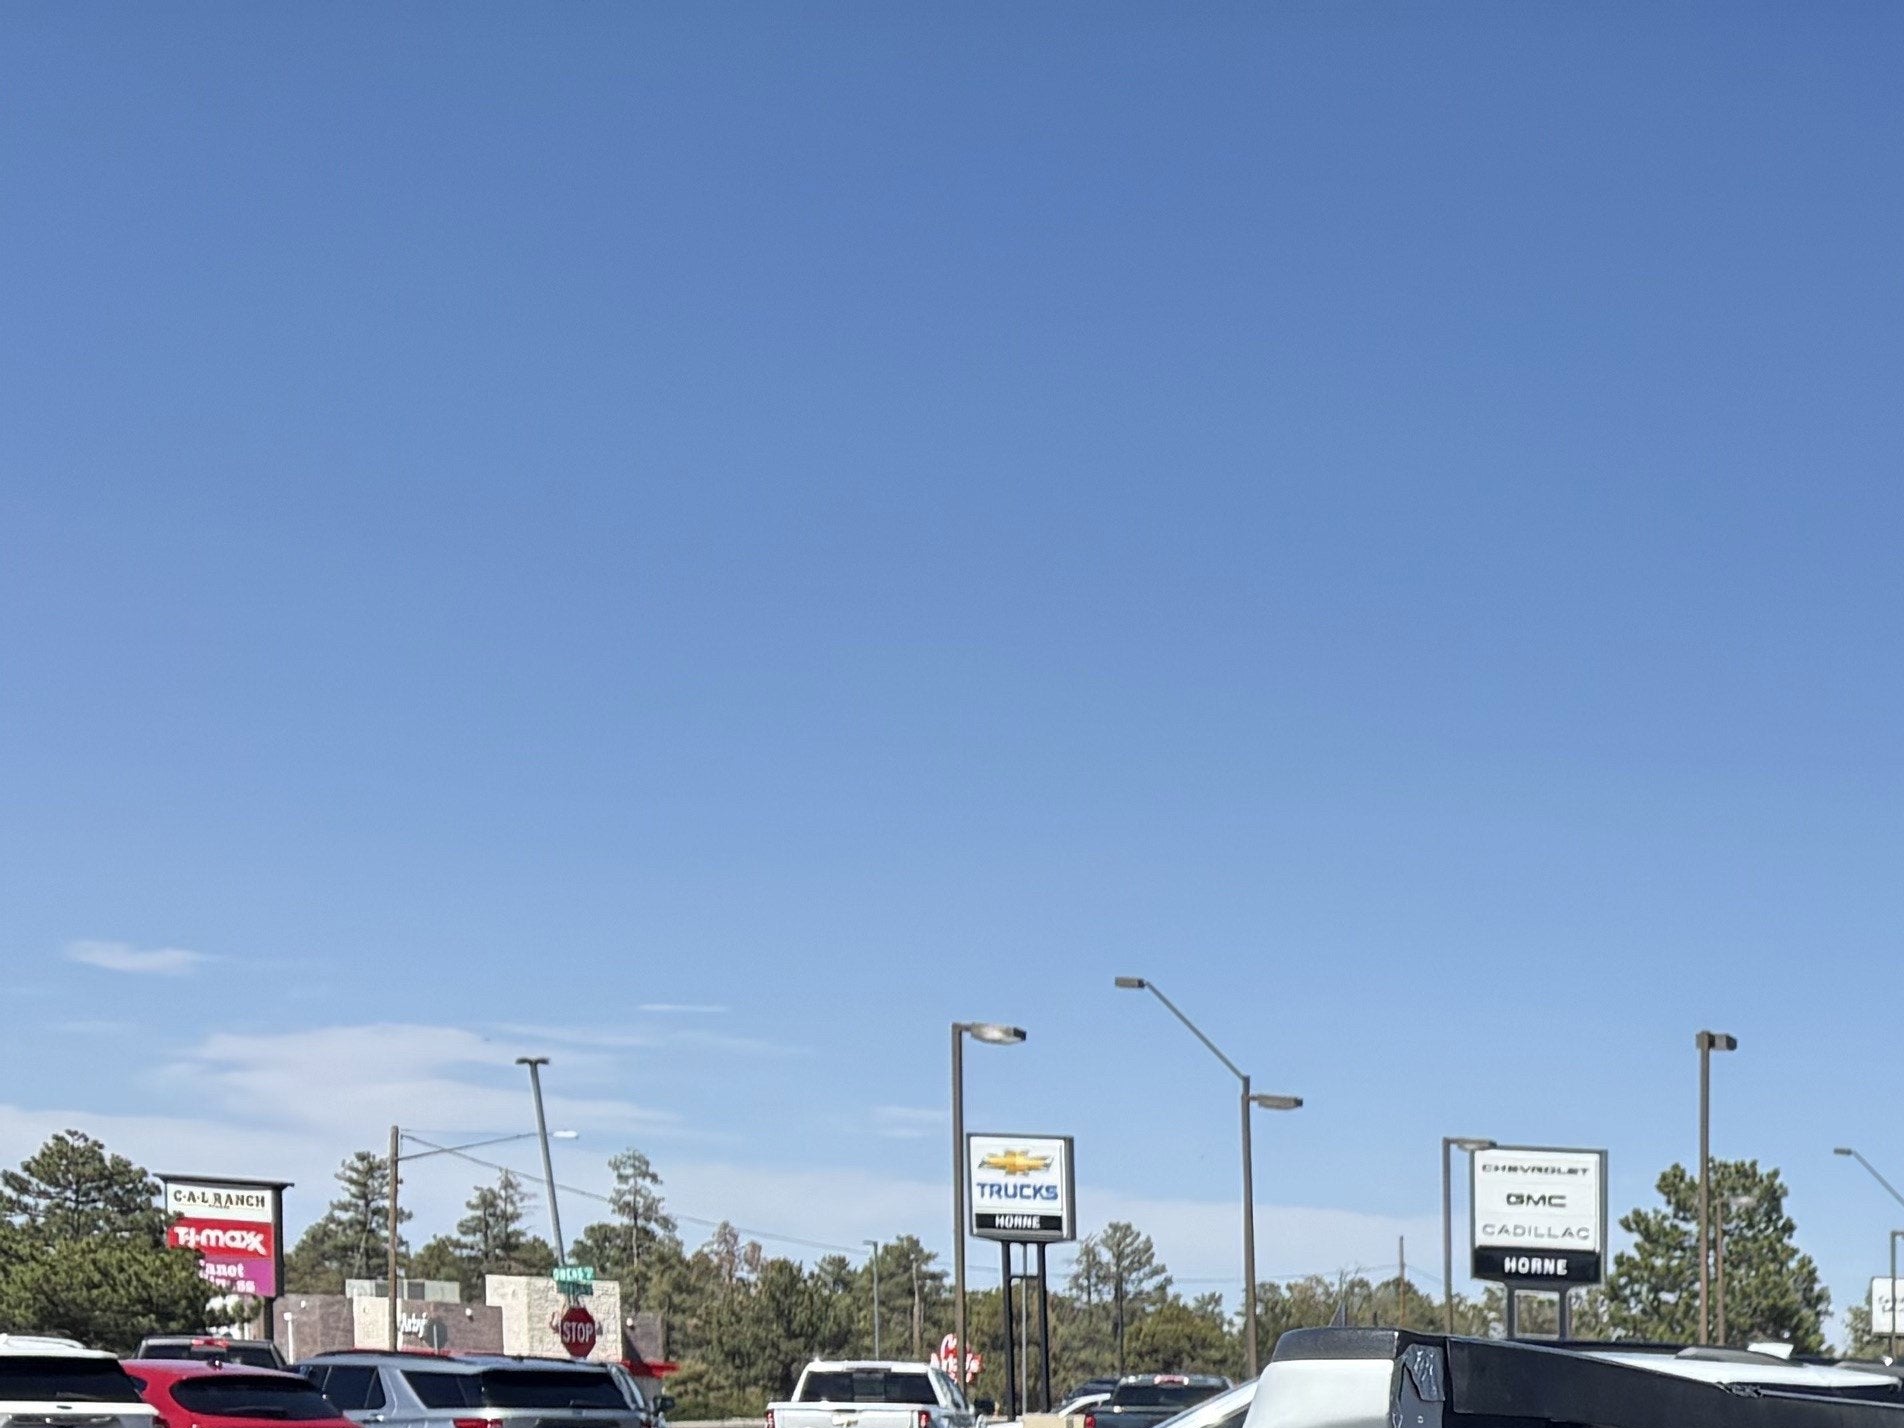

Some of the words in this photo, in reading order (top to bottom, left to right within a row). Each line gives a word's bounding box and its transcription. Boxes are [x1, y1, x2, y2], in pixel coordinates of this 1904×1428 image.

[1481, 1164, 1589, 1176] CHEVROLET
[976, 1182, 1059, 1200] TRUCKS
[212, 1192, 265, 1208] RANCH
[1506, 1193, 1567, 1208] GMC
[1482, 1223, 1590, 1240] CADILLAC
[1504, 1256, 1568, 1275] HORNE
[562, 1321, 593, 1343] STOP
